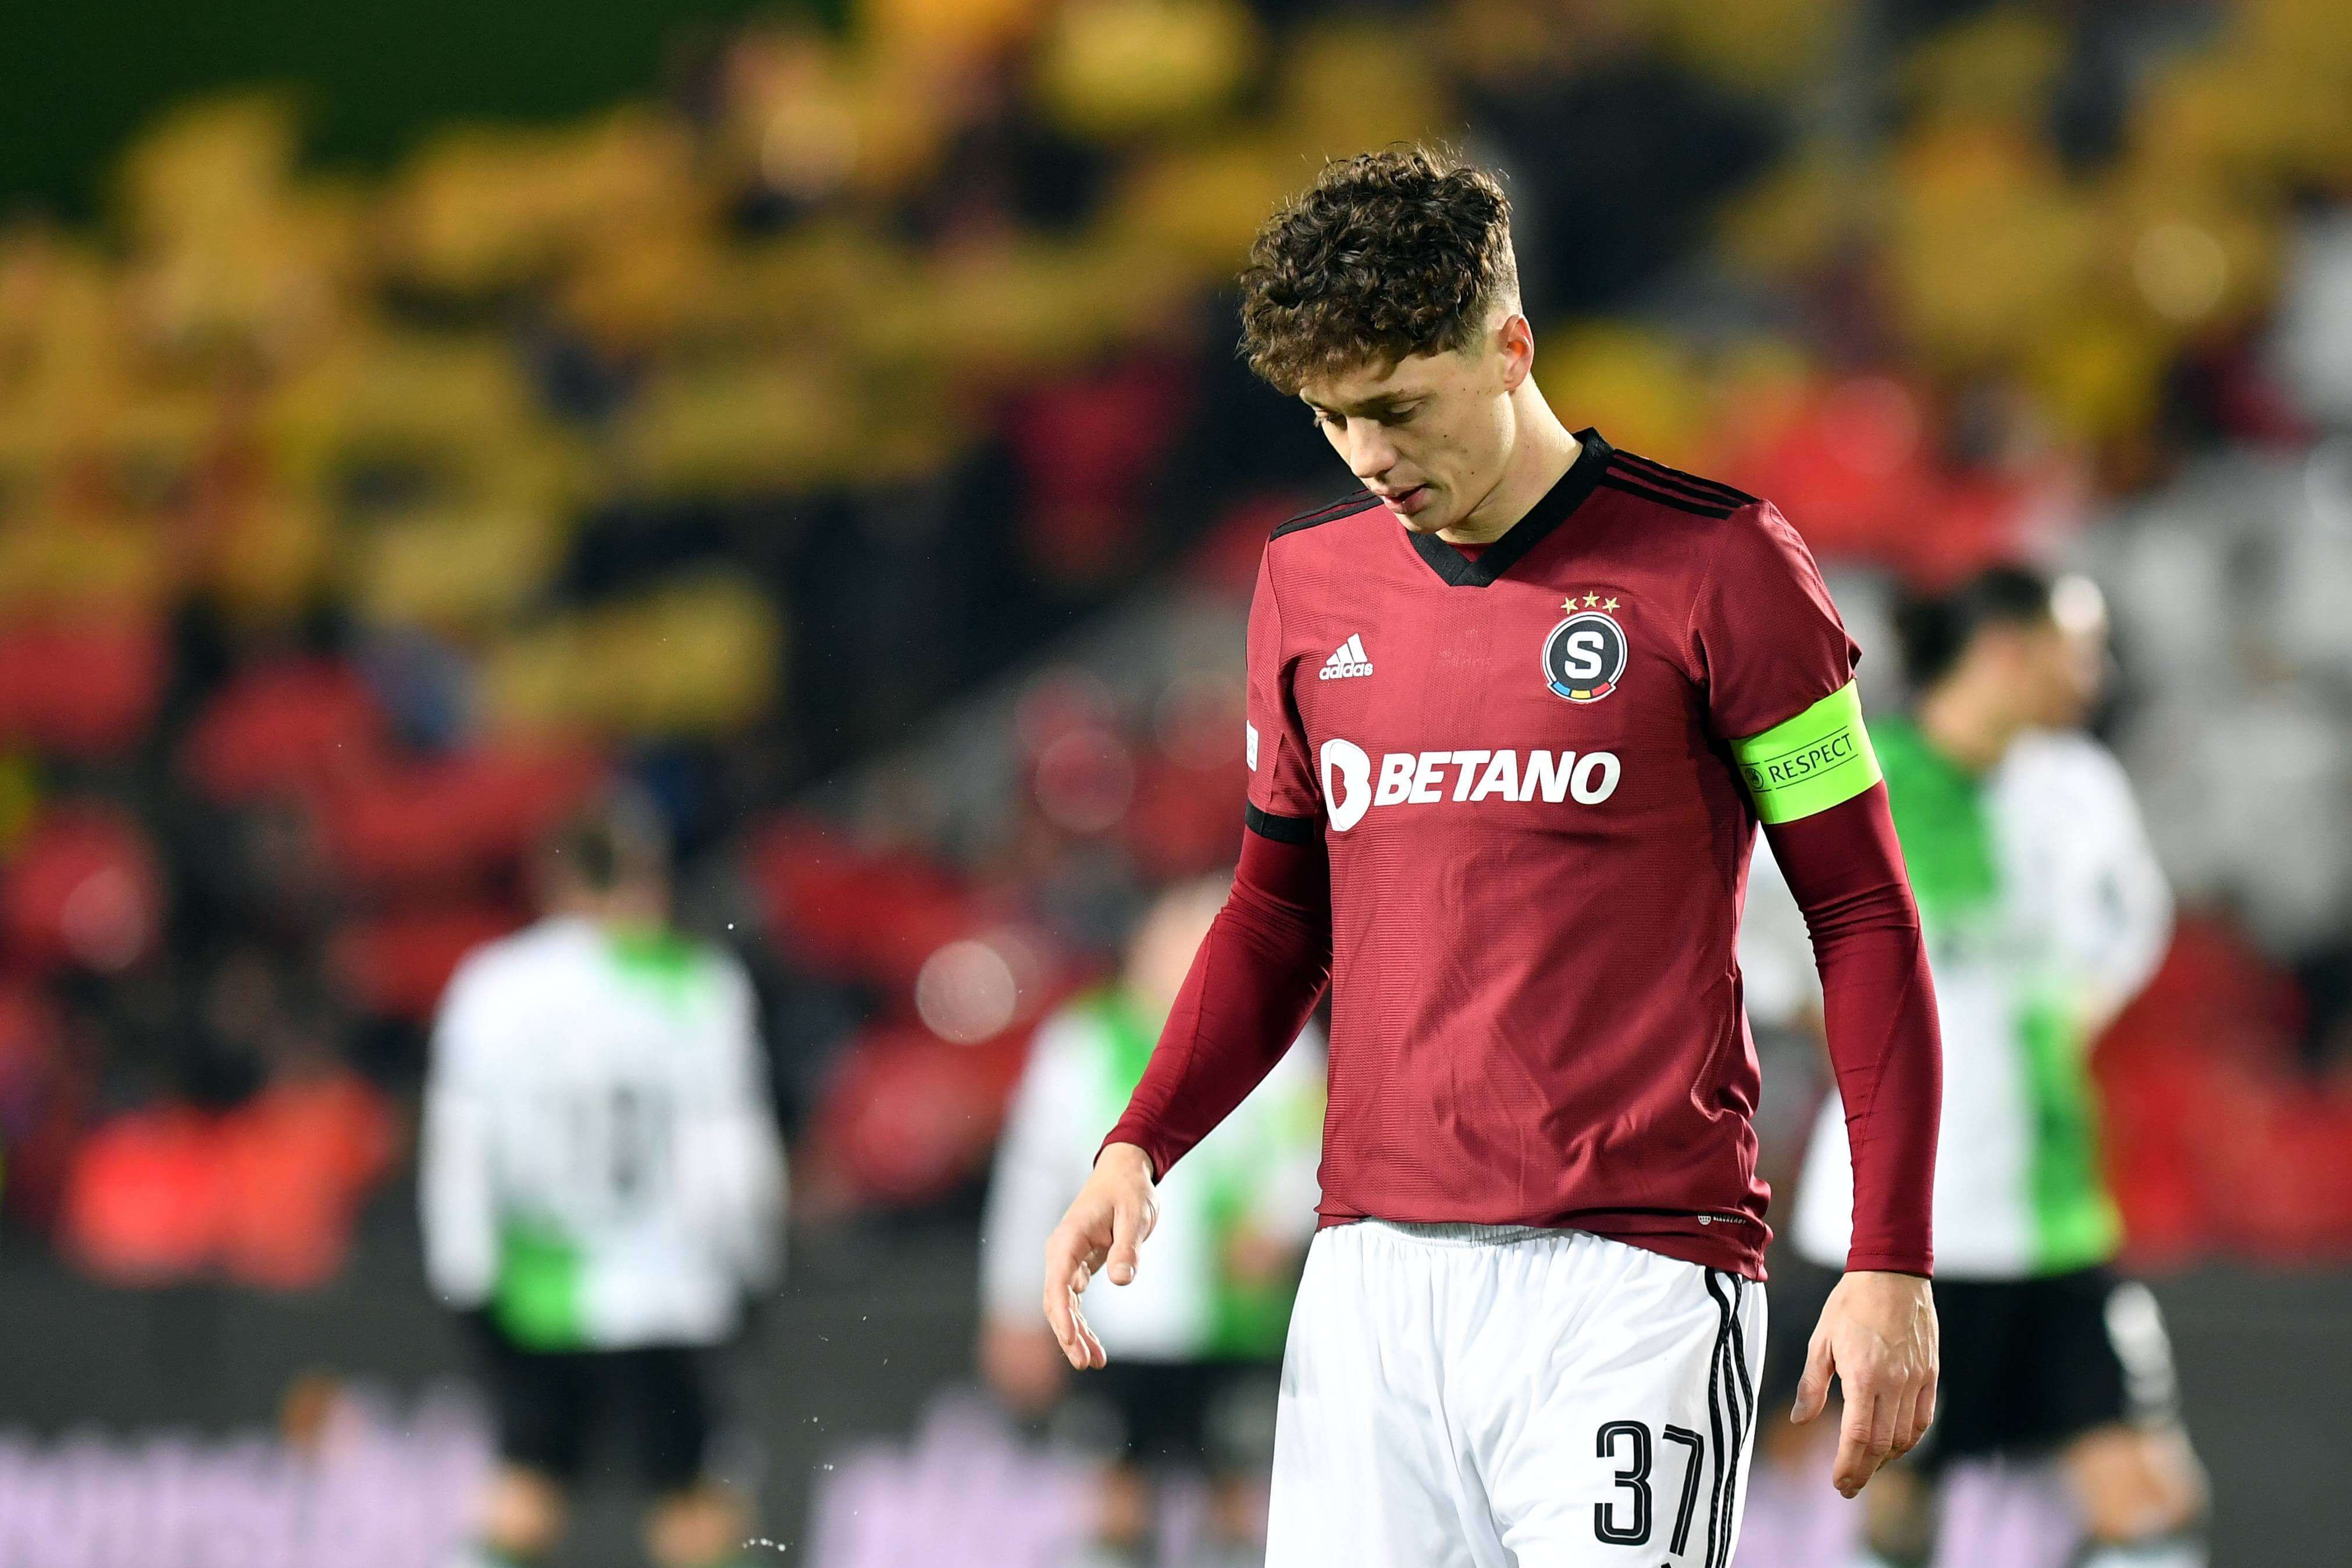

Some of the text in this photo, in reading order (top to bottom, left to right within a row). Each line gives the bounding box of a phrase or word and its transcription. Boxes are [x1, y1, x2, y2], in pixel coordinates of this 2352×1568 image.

[1319, 662, 1373, 680] adidas
[1565, 631, 1604, 679] S
[1374, 750, 1620, 806] BETANO
[1769, 733, 1852, 783] RESPECT
[1595, 1421, 1704, 1557] 37
